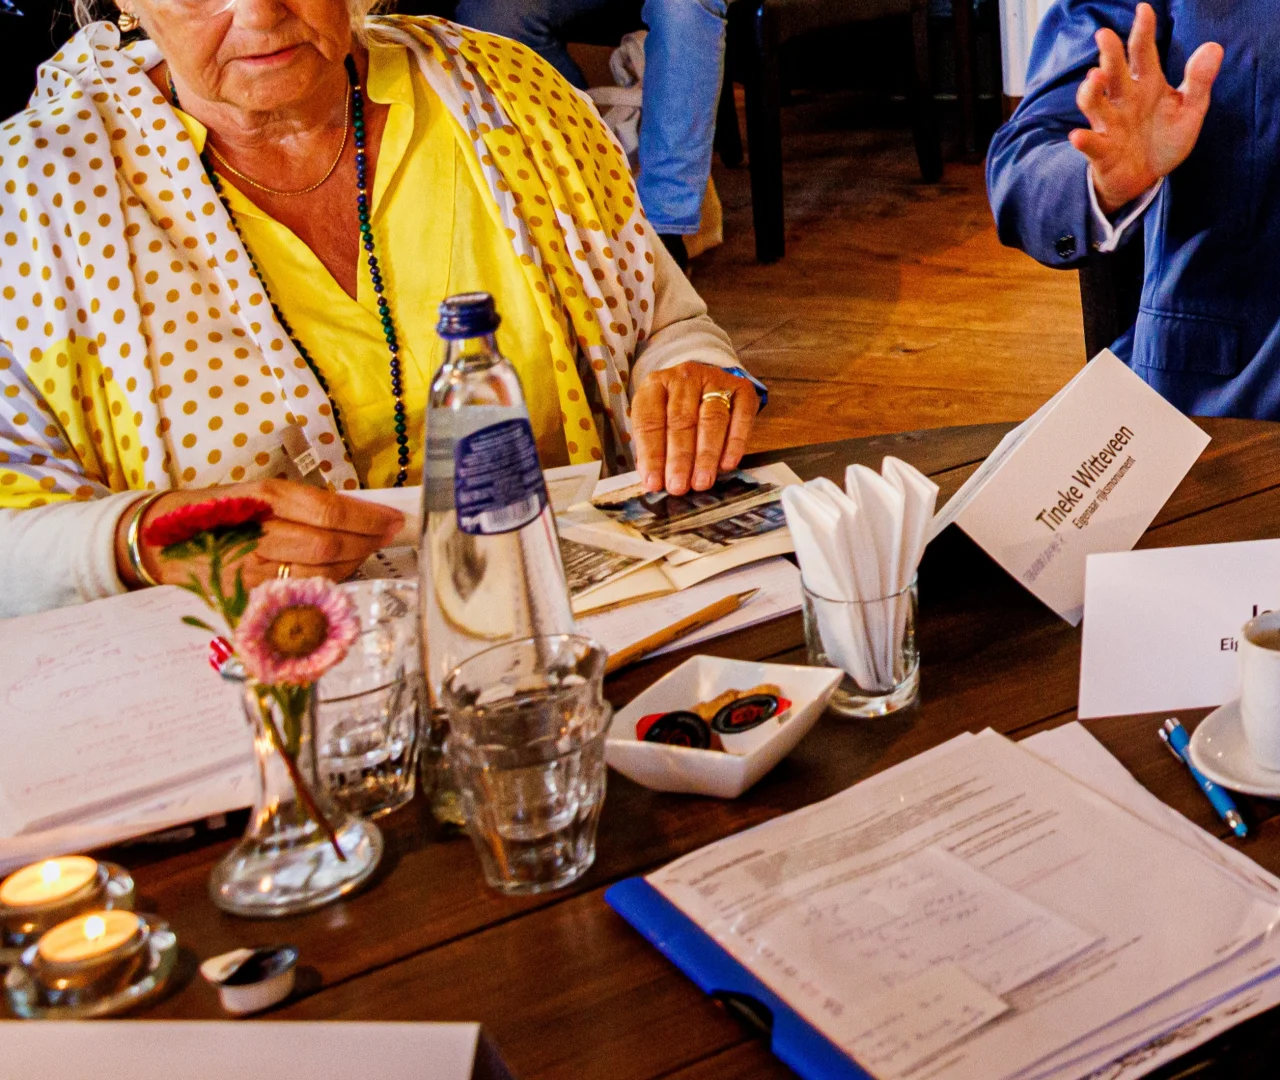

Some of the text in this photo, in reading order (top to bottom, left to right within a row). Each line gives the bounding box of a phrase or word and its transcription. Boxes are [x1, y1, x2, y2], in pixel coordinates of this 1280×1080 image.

[1035, 485, 1084, 531] Tineke
[1071, 425, 1135, 488] Witteveen
[1072, 456, 1137, 530] Eigenaar rijksmonument
